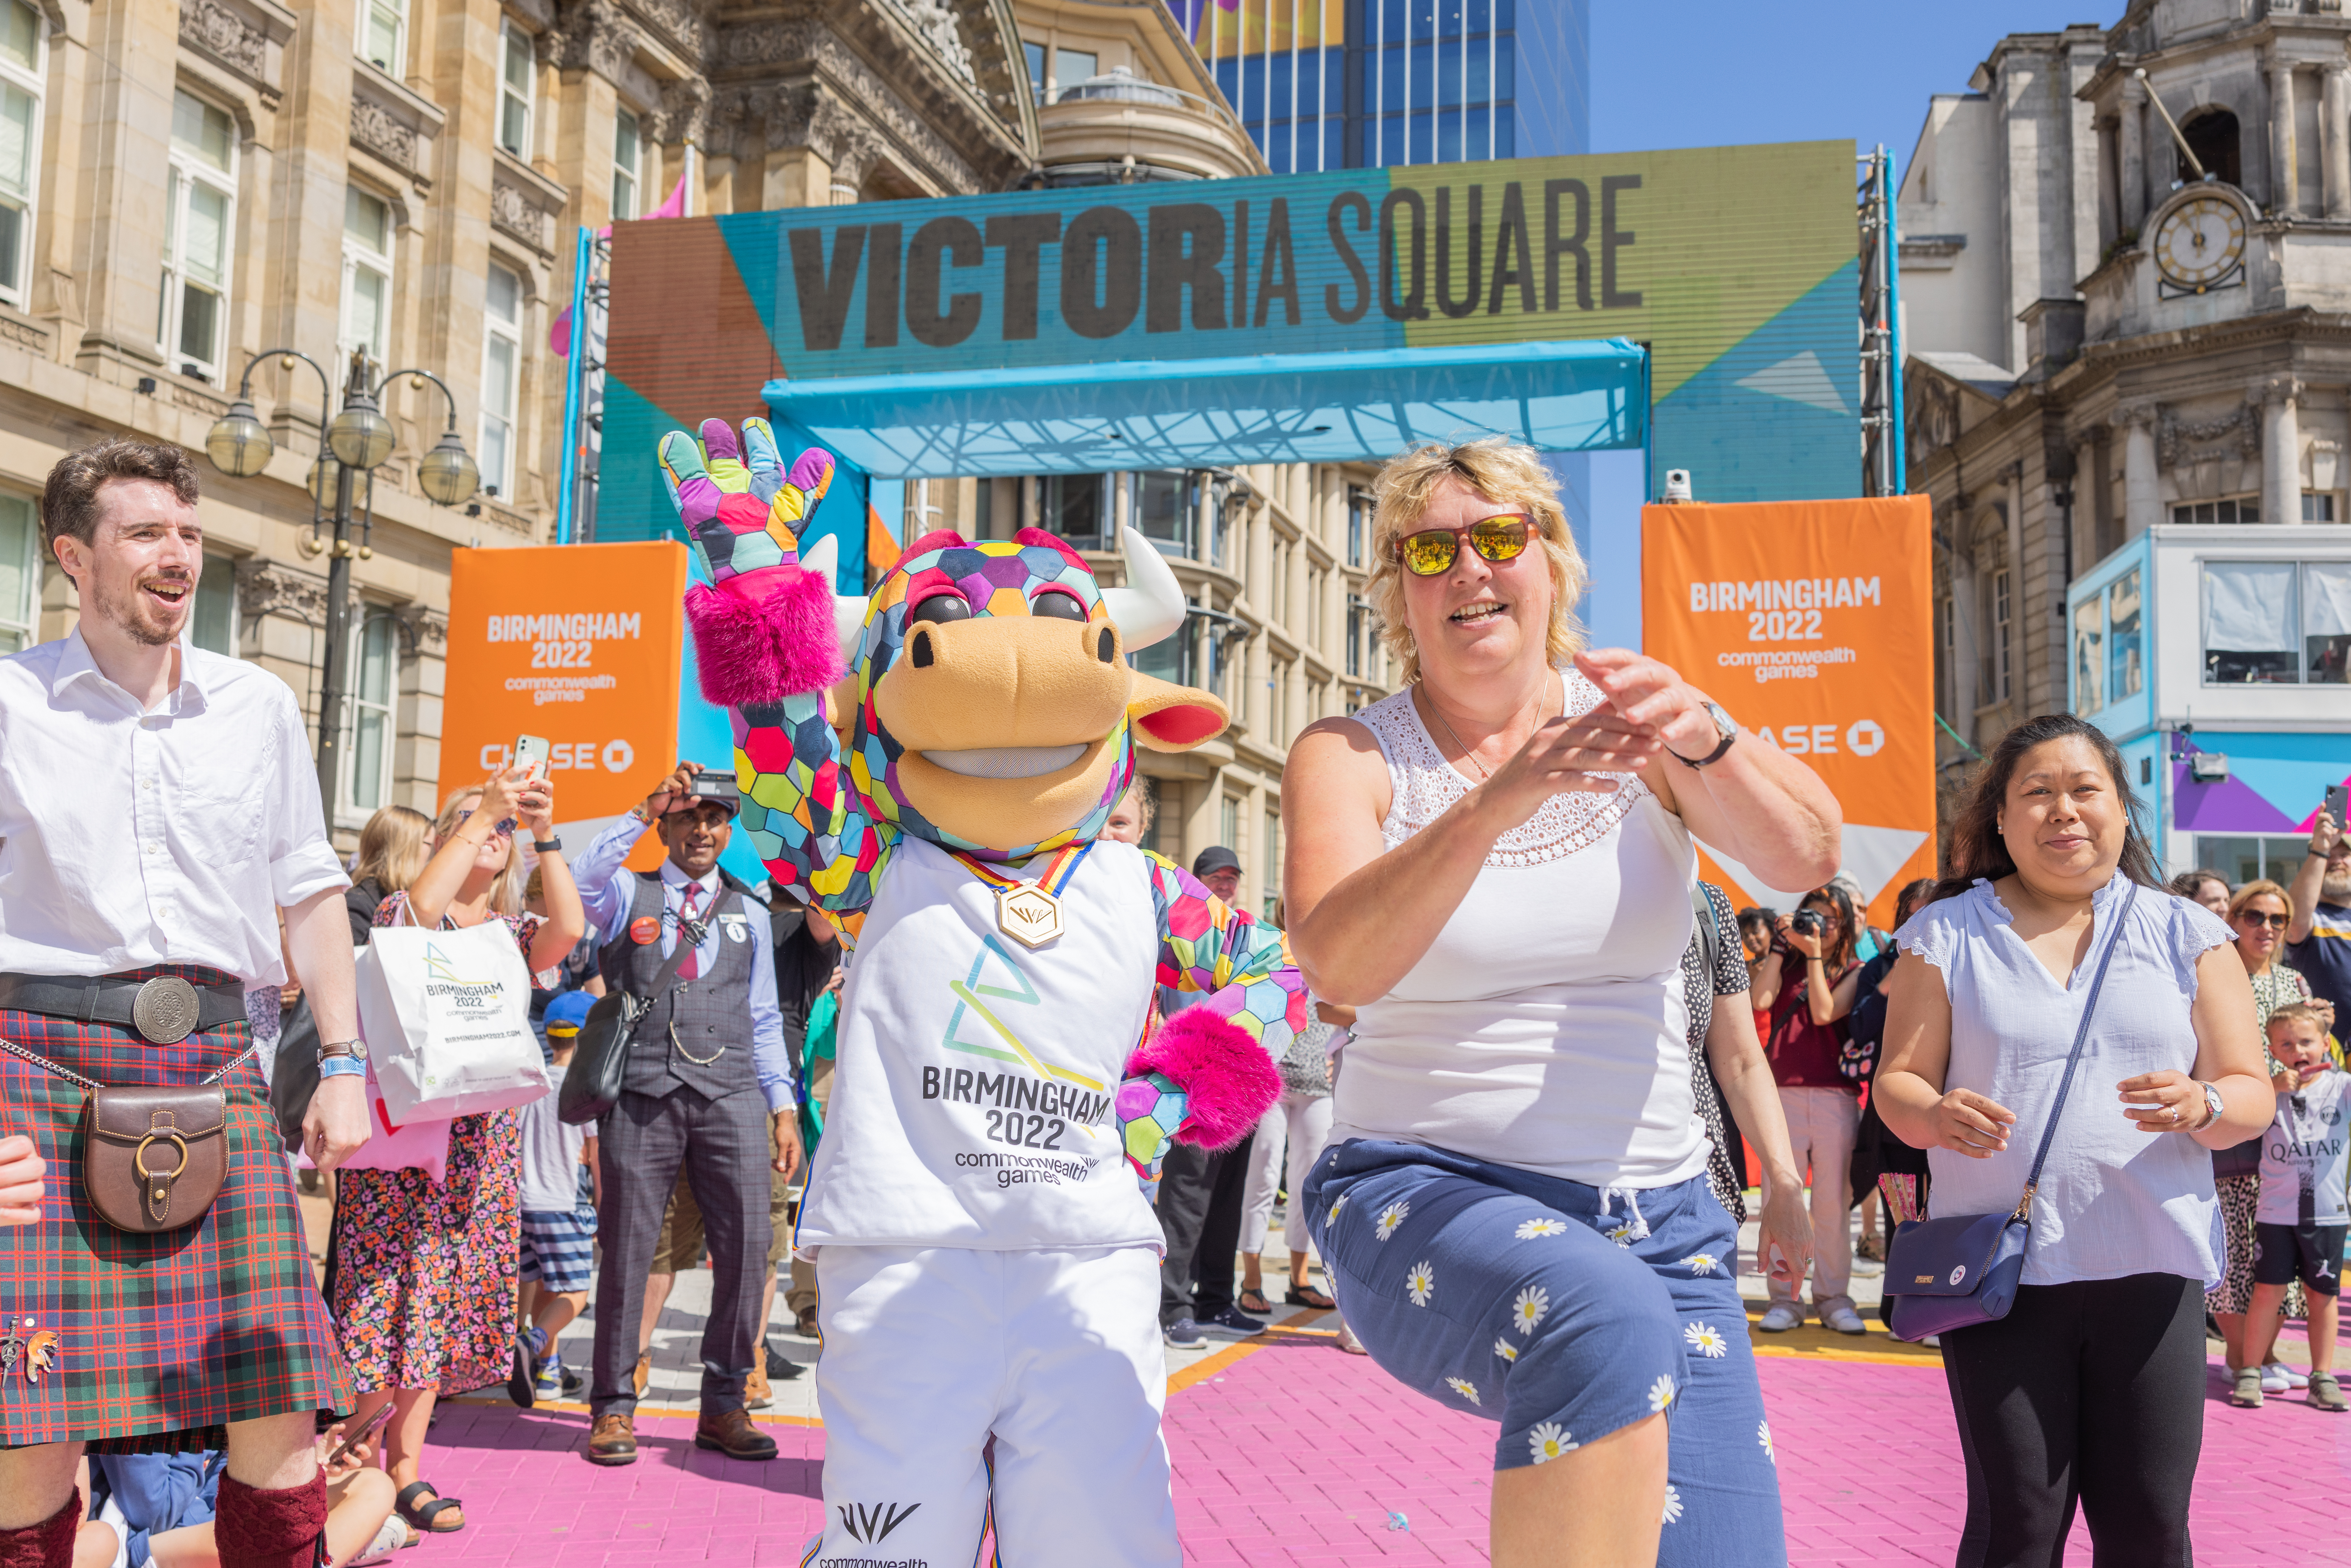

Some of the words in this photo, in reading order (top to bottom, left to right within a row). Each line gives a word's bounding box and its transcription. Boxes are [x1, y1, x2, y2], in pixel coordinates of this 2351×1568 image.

[788, 197, 1301, 351] VICTORIA
[1325, 175, 1643, 324] SQUARE
[1690, 576, 1880, 612] BIRMINGHAM
[487, 612, 641, 642] BIRMINGHAM
[1748, 609, 1823, 641] 2022
[531, 640, 592, 668] 2022
[1717, 647, 1856, 666] commonwealth
[505, 674, 616, 691] commonwealth
[1755, 663, 1818, 683] games
[534, 689, 585, 706] games
[1742, 725, 1838, 754] ASE
[480, 743, 596, 770] CHSE
[426, 982, 503, 996] BIRMINGHAM
[446, 1008, 502, 1016] commonwealth
[454, 997, 484, 1007] 2022
[445, 1030, 521, 1043] BIRMINGHAM2022.COM
[923, 1066, 1111, 1126] BIRMINGHAM
[986, 1110, 1066, 1151] 2022
[2271, 1139, 2340, 1163] QATAR
[955, 1153, 1088, 1182] commonwealth
[998, 1169, 1061, 1188] games
